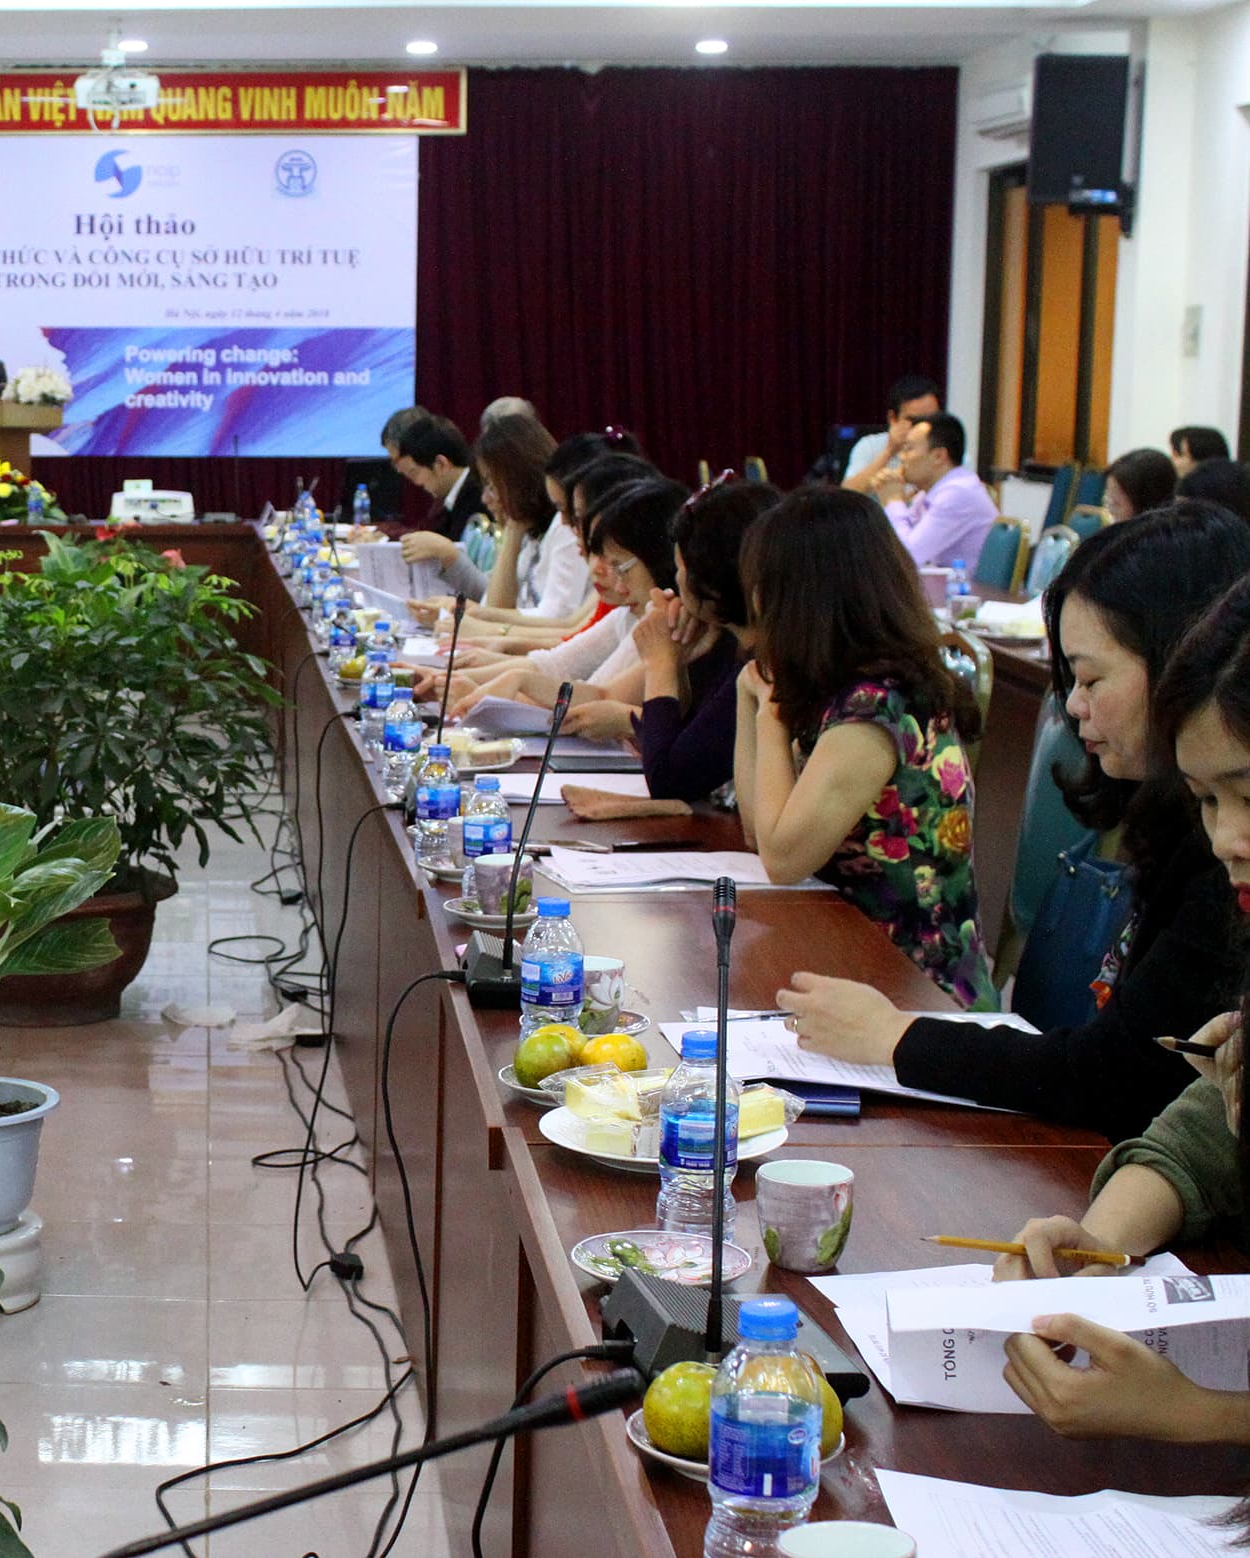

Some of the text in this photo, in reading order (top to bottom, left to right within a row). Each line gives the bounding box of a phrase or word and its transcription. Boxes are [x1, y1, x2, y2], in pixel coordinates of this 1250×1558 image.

[27, 80, 78, 127] VIỆT
[152, 86, 232, 124] QUANG
[239, 86, 296, 121] VINH
[305, 80, 380, 121] MUÔN
[386, 80, 445, 121] NĂM
[74, 213, 196, 241] Hội thảo
[54, 245, 82, 265] VÀ
[88, 245, 150, 265] CÔNG
[155, 249, 184, 269] CỤ
[224, 245, 271, 265] HỮU
[277, 244, 313, 265] TRÍ
[171, 269, 228, 288] SÁNG
[234, 271, 279, 291] TẠO
[125, 345, 299, 366] Powering change:
[124, 367, 371, 386] Women in innovation and
[125, 389, 214, 412] creativity
